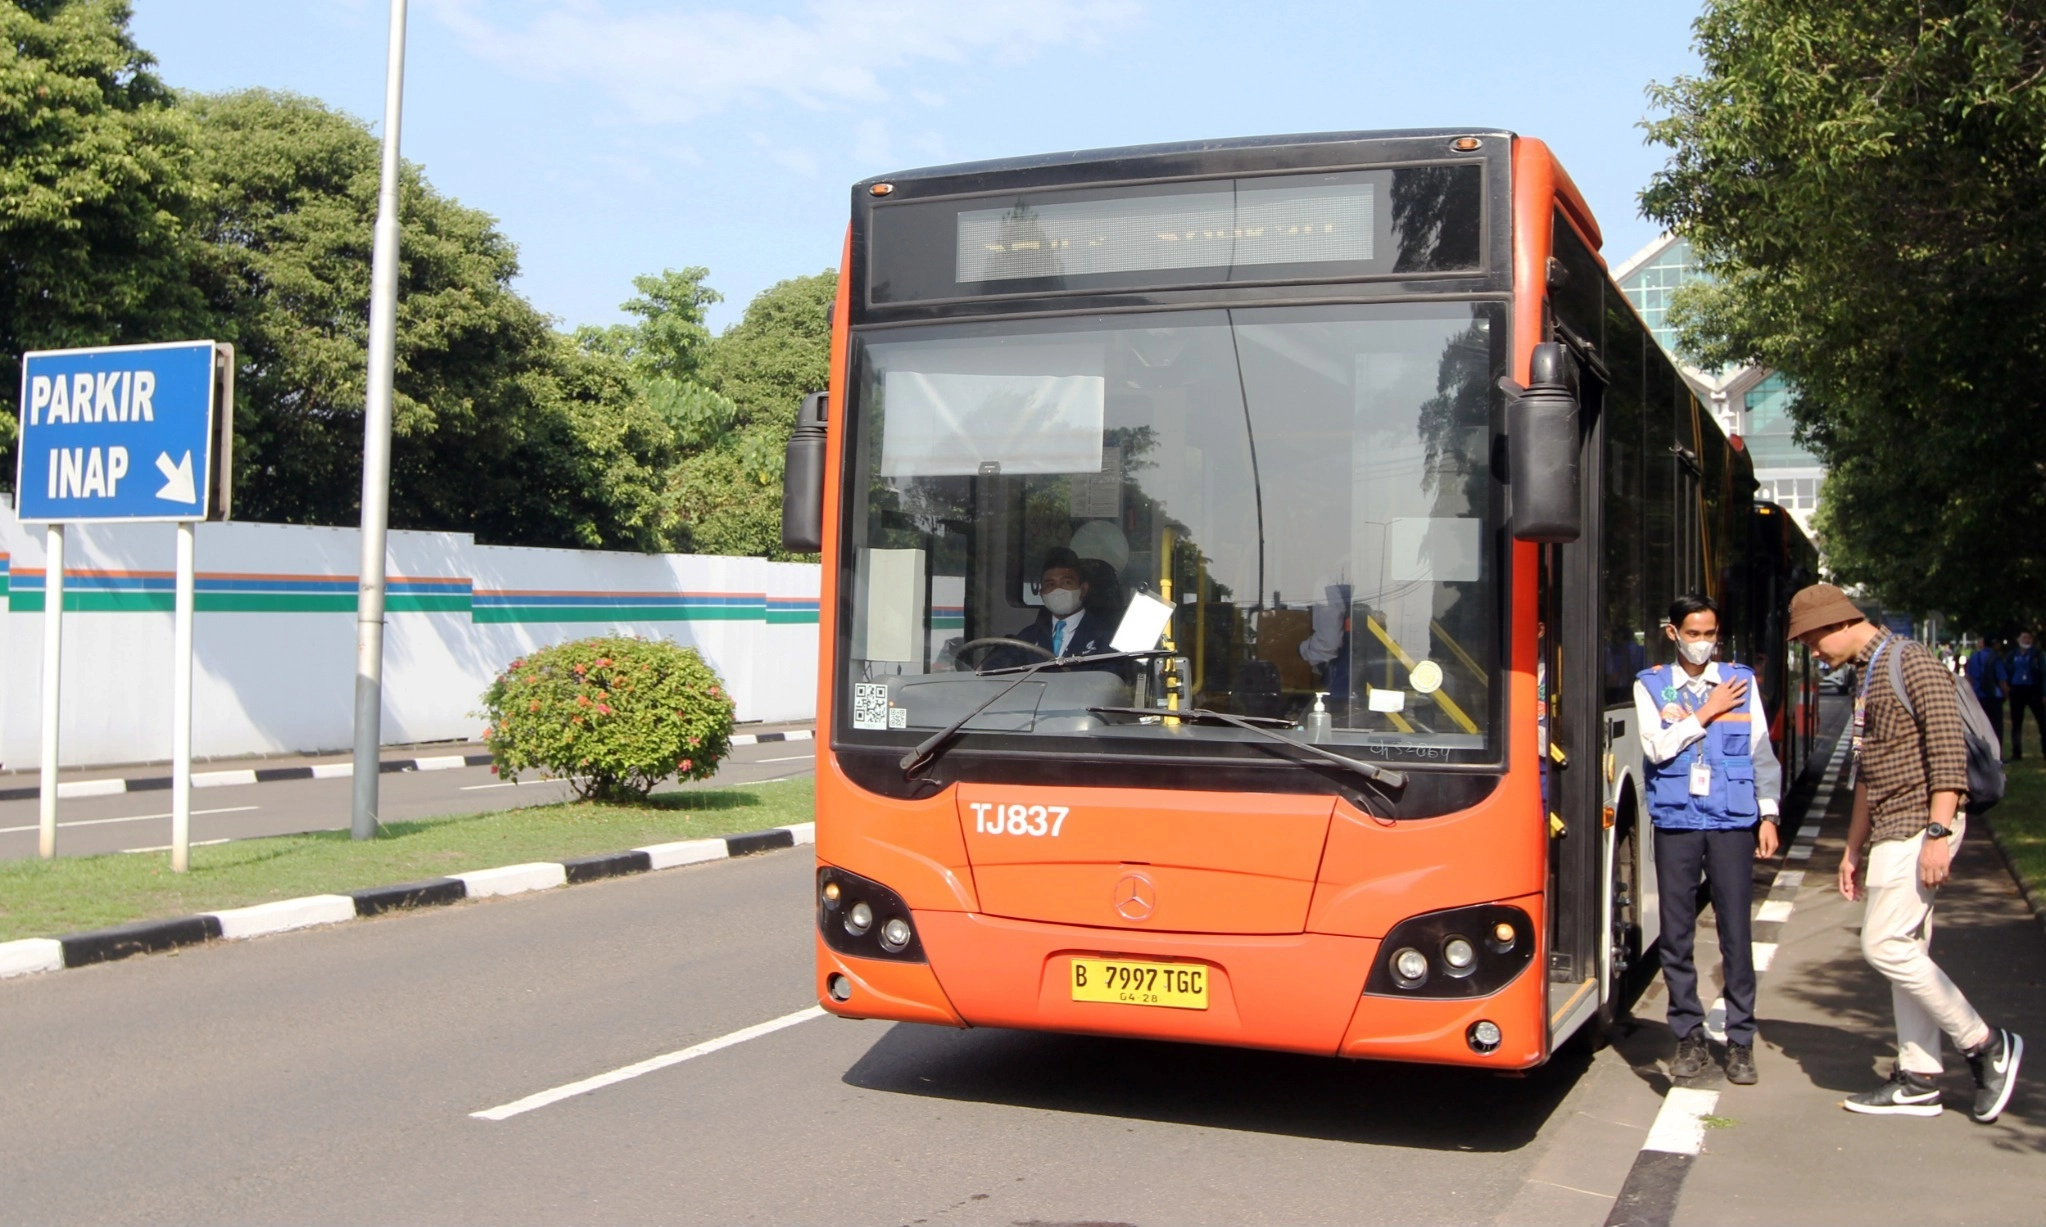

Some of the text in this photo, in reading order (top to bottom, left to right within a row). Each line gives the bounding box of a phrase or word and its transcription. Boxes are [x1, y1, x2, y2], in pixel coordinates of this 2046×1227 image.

[30, 370, 156, 426] PARKIR
[48, 446, 129, 499] INAP
[970, 803, 1070, 837] TJ837
[1076, 965, 1203, 994] B 7997 TGC
